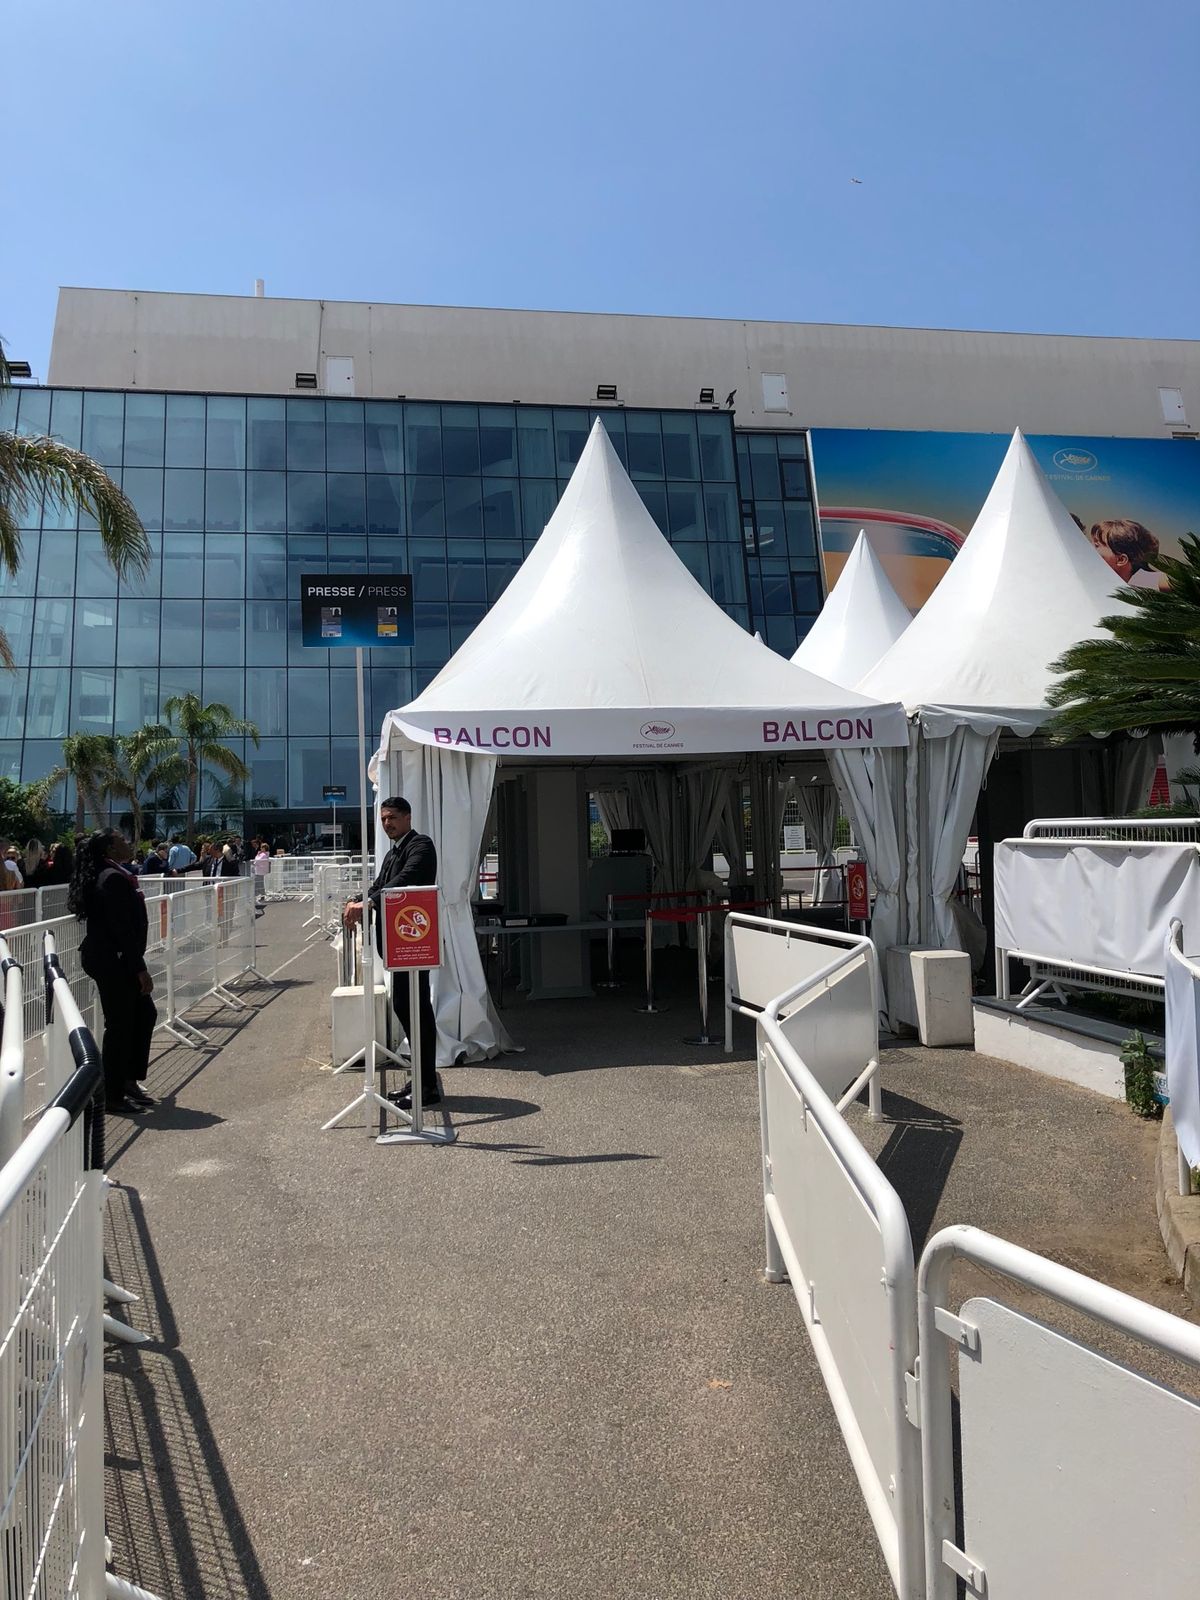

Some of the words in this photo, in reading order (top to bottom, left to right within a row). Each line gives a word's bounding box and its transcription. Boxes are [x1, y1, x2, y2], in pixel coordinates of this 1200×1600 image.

[307, 586, 356, 597] PRESSE
[368, 586, 407, 597] PRESS
[433, 726, 551, 748] BALCON
[762, 718, 874, 743] BALCON
